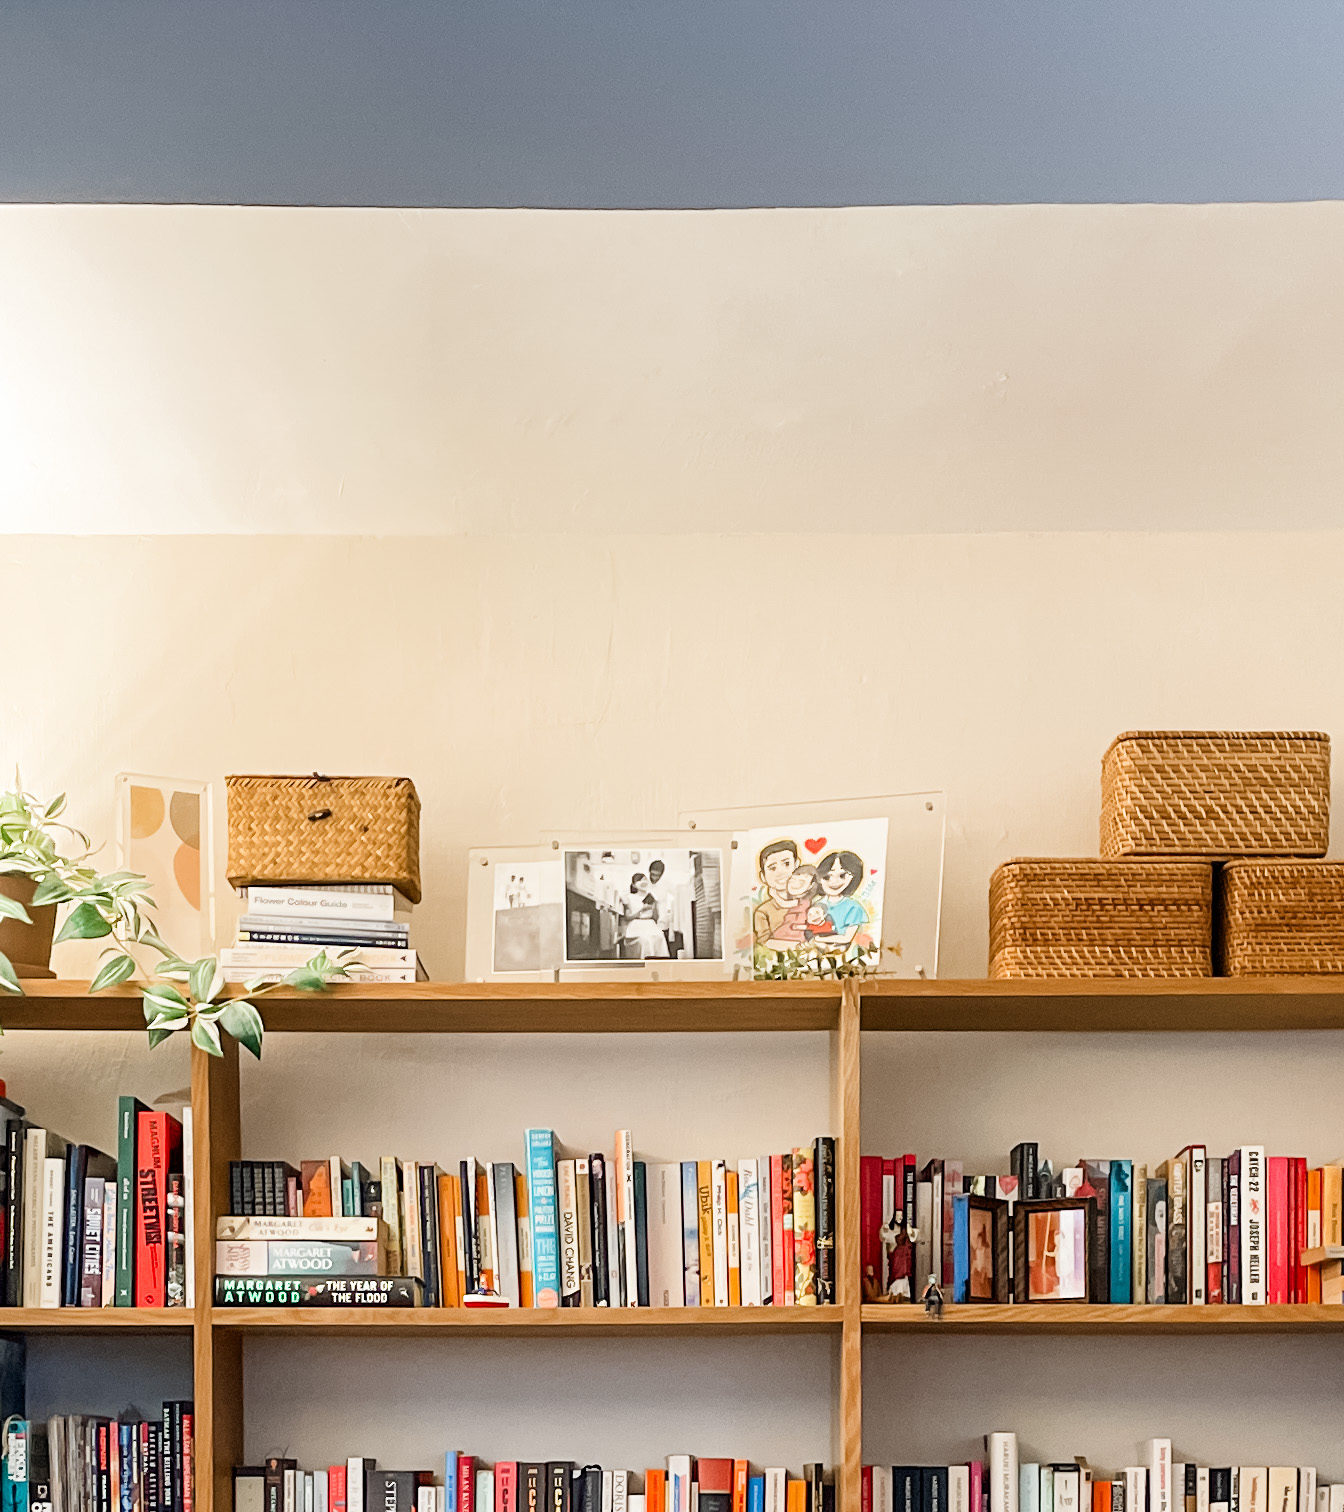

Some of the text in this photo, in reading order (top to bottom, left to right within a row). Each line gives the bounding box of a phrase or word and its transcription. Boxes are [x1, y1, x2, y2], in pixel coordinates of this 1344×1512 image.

[254, 896, 348, 909] Flower Colour Guide
[149, 1121, 161, 1169] MAGNUM
[699, 1185, 712, 1215] Ubik
[744, 1201, 754, 1227] Dahl
[254, 1220, 303, 1229] MARGARET
[563, 1212, 574, 1244] DAVID
[1249, 1151, 1259, 1284] CATCH-22 JOSEPH HELLER
[85, 1244, 101, 1275] CITIES
[272, 1248, 332, 1258] MARGARET
[272, 1258, 332, 1270] ATWOOD
[565, 1247, 576, 1289] CHANG
[224, 1280, 393, 1291] MARGARET THE YEAR OF
[224, 1292, 388, 1303] ATWOOD THE FLOOD
[615, 1475, 624, 1512] DORIS
